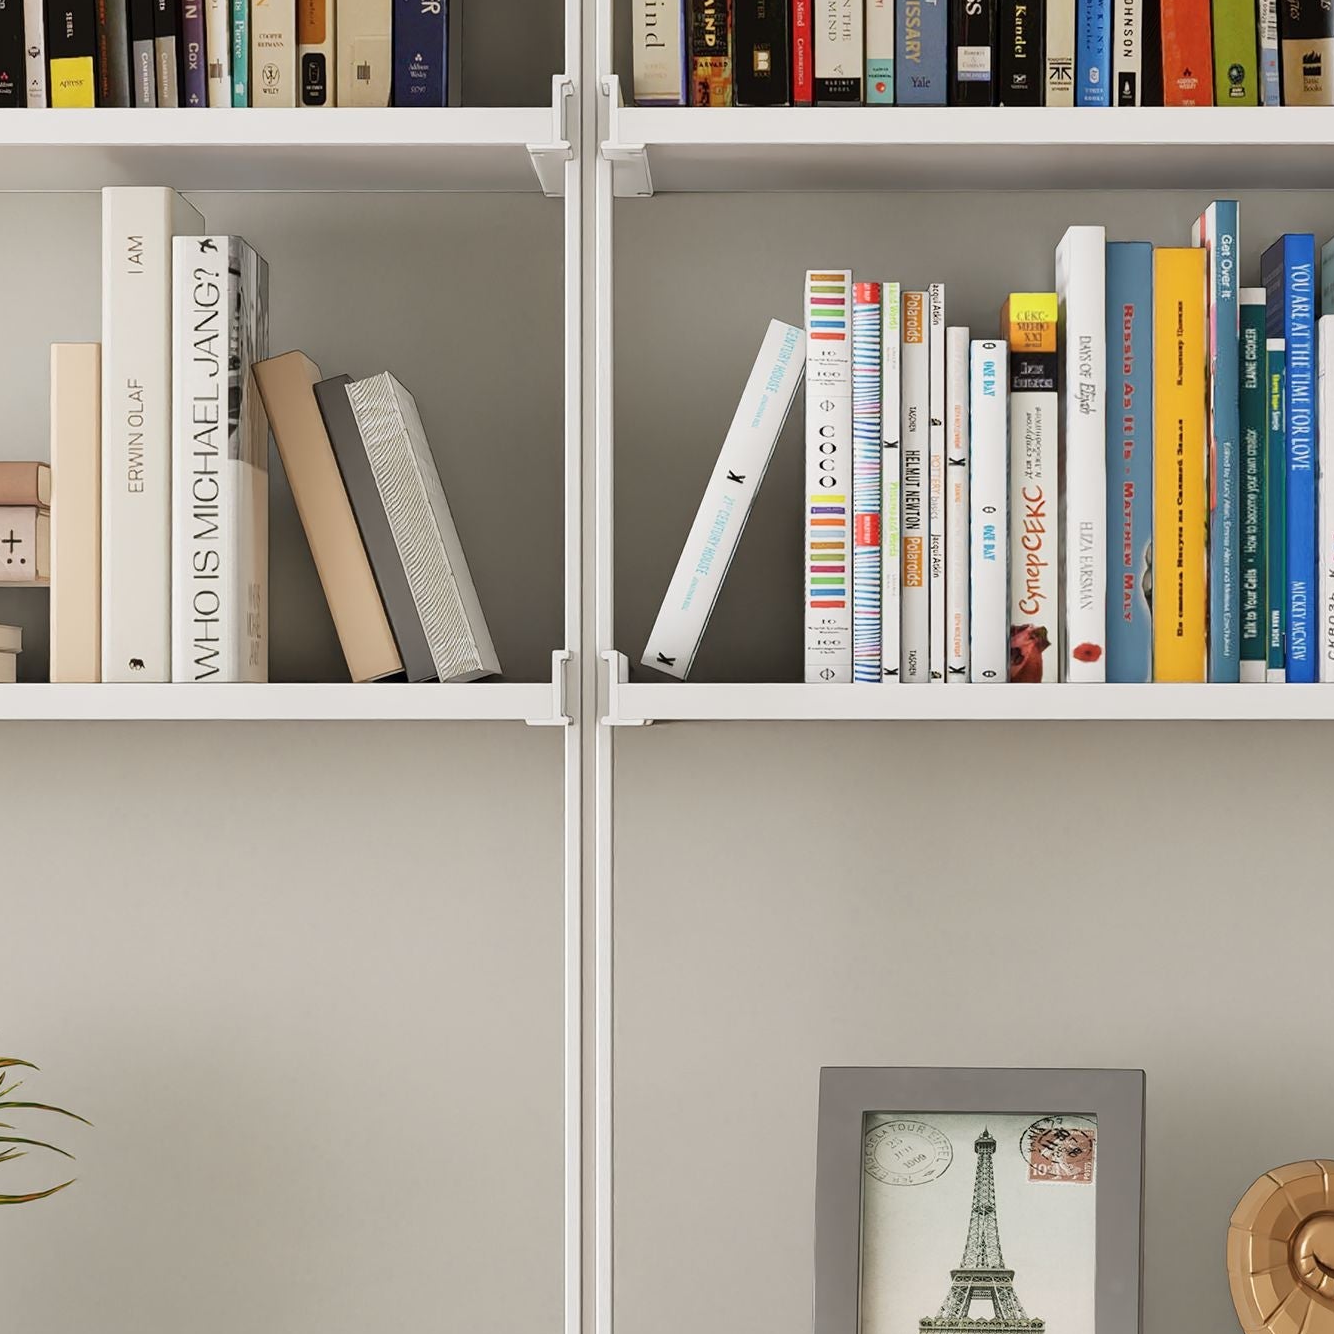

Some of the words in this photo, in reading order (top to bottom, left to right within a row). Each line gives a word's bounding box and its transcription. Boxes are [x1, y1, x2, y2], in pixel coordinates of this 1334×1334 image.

[66, 11, 74, 38] SEIBEL
[188, 42, 198, 70] Cox
[912, 76, 930, 88] Yale
[1290, 263, 1310, 292] YOU
[193, 268, 220, 377] JANG?
[906, 294, 920, 342] Polaroids
[1292, 295, 1310, 319] ARE
[1292, 323, 1310, 338] AT
[1292, 342, 1310, 368] THE
[128, 378, 144, 427] OLAF
[1292, 372, 1310, 404] TIME
[1292, 408, 1310, 436] FOR
[128, 432, 144, 494] ERWIN
[193, 383, 220, 540] MICHAEL
[818, 424, 836, 489] COCO
[905, 450, 920, 489] HELMUT
[1292, 439, 1311, 470] LOVE
[905, 492, 920, 530] NEWTON
[193, 550, 220, 580] IS
[906, 536, 920, 587] Polaroids
[1018, 485, 1045, 616] СуперСЕКС
[193, 590, 220, 680] WHO
[890, 1124, 925, 1134] TOUR
[929, 1131, 948, 1162] EIFFEL
[1032, 1164, 1047, 1176] 10
